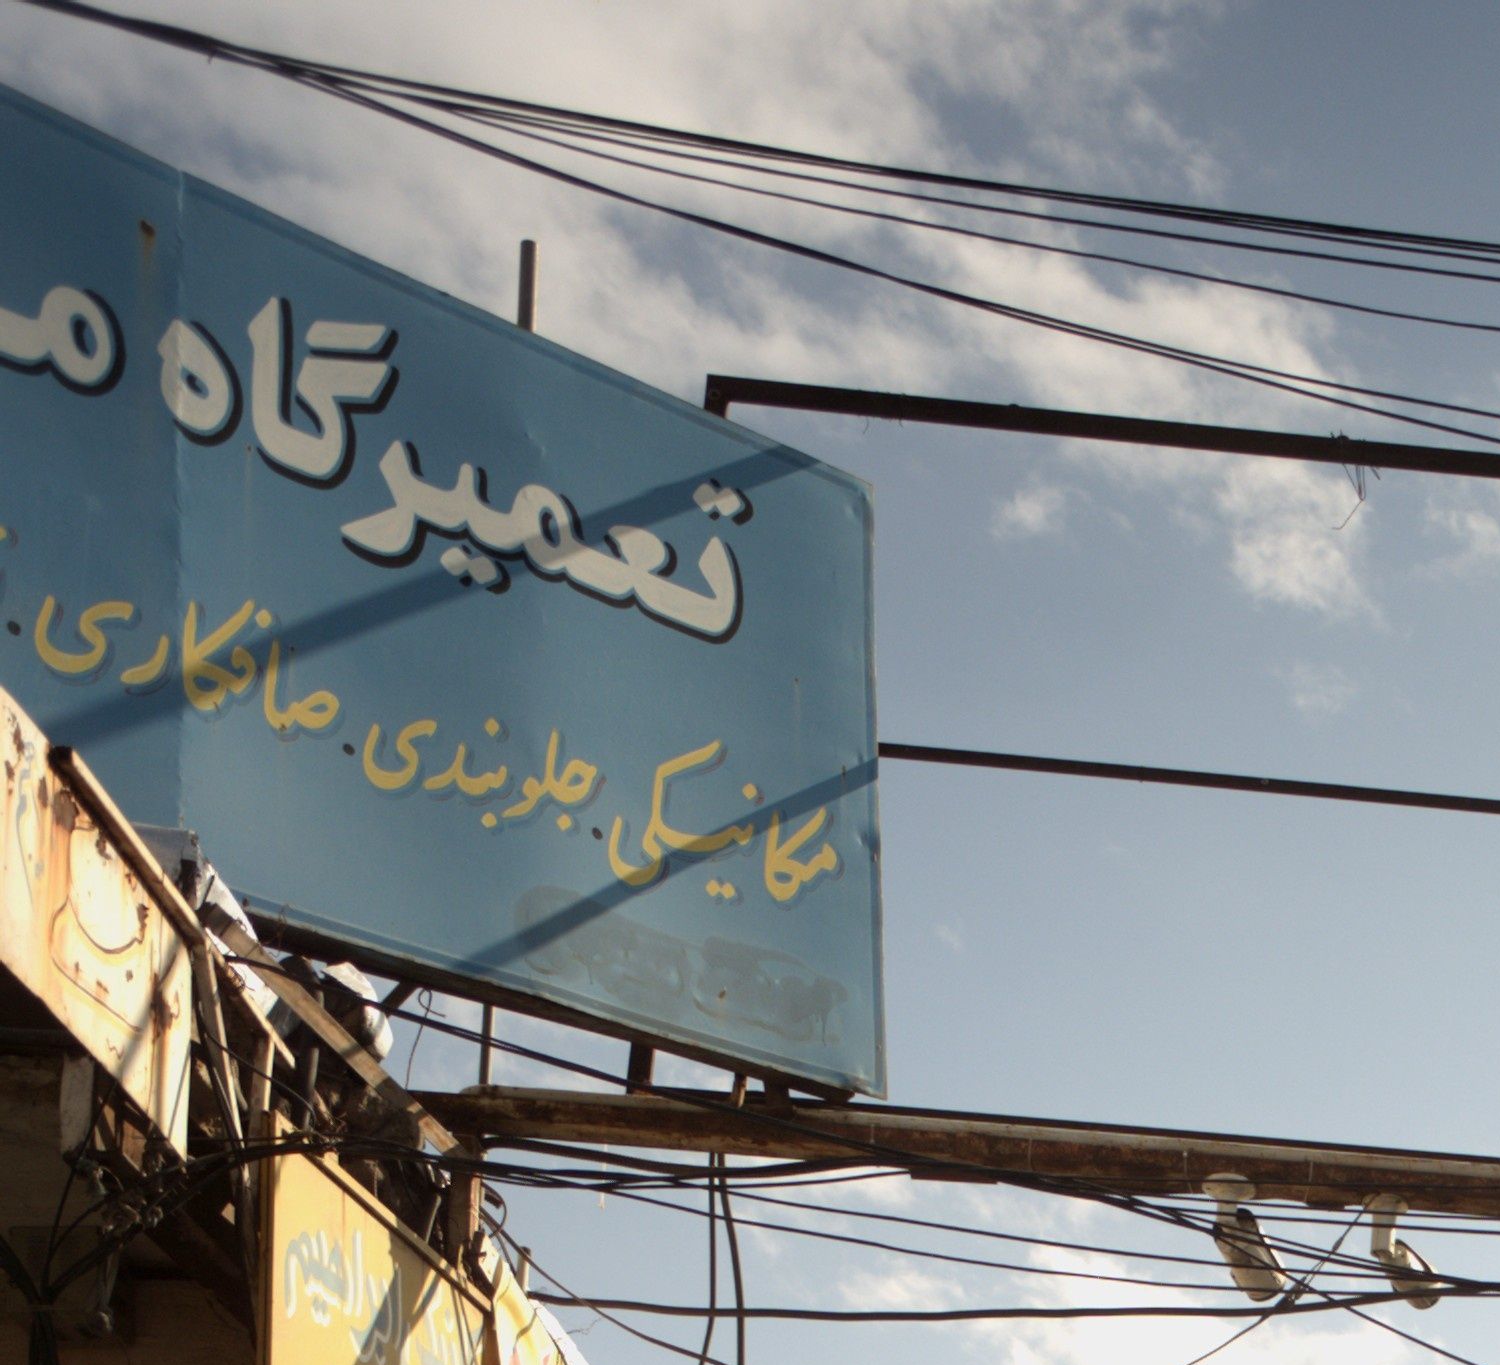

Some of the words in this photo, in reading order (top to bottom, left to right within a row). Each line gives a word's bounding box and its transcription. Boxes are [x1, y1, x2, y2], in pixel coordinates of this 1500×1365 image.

[34, 594, 340, 731] صافکاری
[362, 719, 599, 828] جلوبندی
[609, 740, 838, 901] مکانیکی
